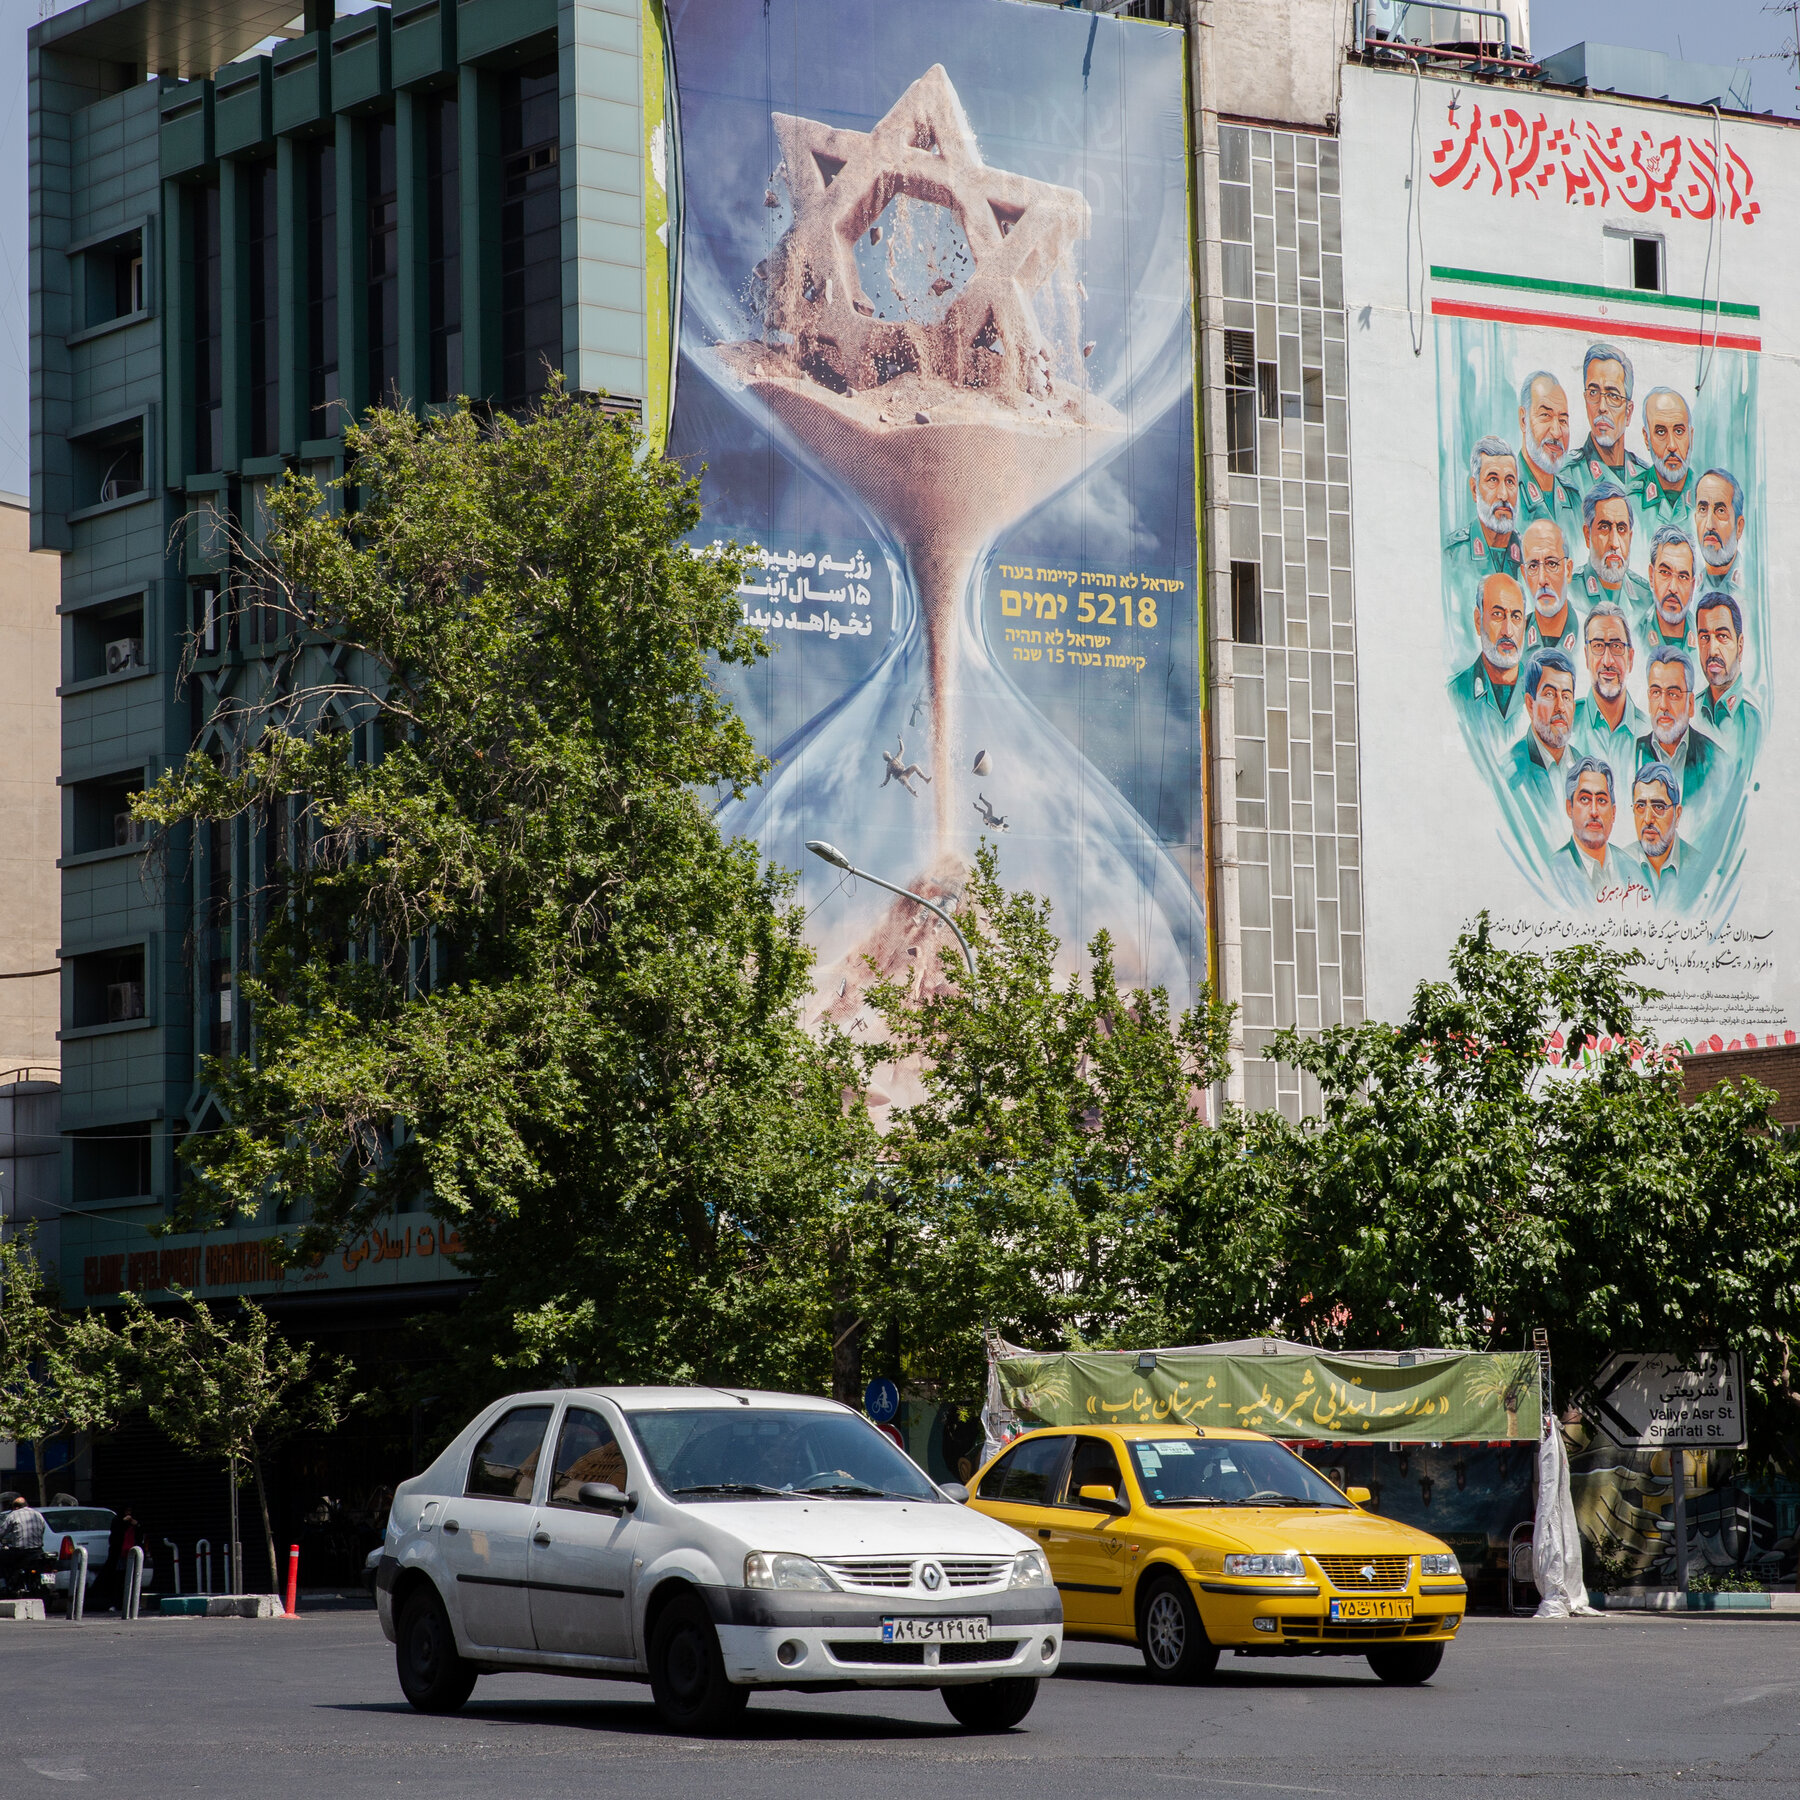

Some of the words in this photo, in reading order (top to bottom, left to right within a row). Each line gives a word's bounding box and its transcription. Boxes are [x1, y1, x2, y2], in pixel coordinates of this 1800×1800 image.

[818, 549, 872, 580] رژیم
[999, 564, 1034, 581] בעוד
[1036, 568, 1078, 587] קיימת
[1081, 572, 1117, 588] תהיה
[1119, 571, 1139, 589] לא
[1140, 573, 1185, 593] ישראל
[788, 576, 845, 603] سال
[847, 583, 871, 606] ۱۵
[999, 588, 1068, 620] ימים
[1077, 591, 1158, 628] 5218
[784, 610, 872, 640] نخواهد
[1005, 628, 1042, 644] תהיה
[1045, 628, 1064, 646] לא
[1066, 628, 1112, 648] ישראל
[1013, 647, 1042, 662] שנה
[1047, 648, 1065, 663] 15
[1067, 651, 1102, 667] בעוד
[1104, 654, 1146, 673] קיימת
[1511, 919, 1536, 936] اسلامی
[1534, 920, 1562, 938] جمهوری
[1561, 921, 1579, 938] برای
[1581, 923, 1598, 938] بودند
[1598, 917, 1622, 938] ارزشمند
[1657, 919, 1672, 939] که
[1665, 921, 1681, 944] شهید
[1681, 919, 1713, 941] دانشمندان
[1732, 928, 1774, 943] سرداران
[1656, 948, 1679, 975] پاداش
[1711, 949, 1741, 969] پیشگاه
[1743, 960, 1751, 969] در
[1752, 957, 1770, 973] امروز
[342, 1226, 412, 1272] اسلامی
[1152, 1375, 1217, 1420] شهرستان
[1273, 1369, 1317, 1427] شجره
[1659, 1382, 1719, 1403] شریعتی
[1236, 1383, 1271, 1428] طیبه
[1313, 1376, 1378, 1430] ابتدایی
[1650, 1408, 1689, 1422] Valiye
[1692, 1408, 1715, 1420] Asr
[1718, 1407, 1735, 1419] St.
[1650, 1425, 1703, 1437] Shari'ati
[1707, 1424, 1724, 1437] St.
